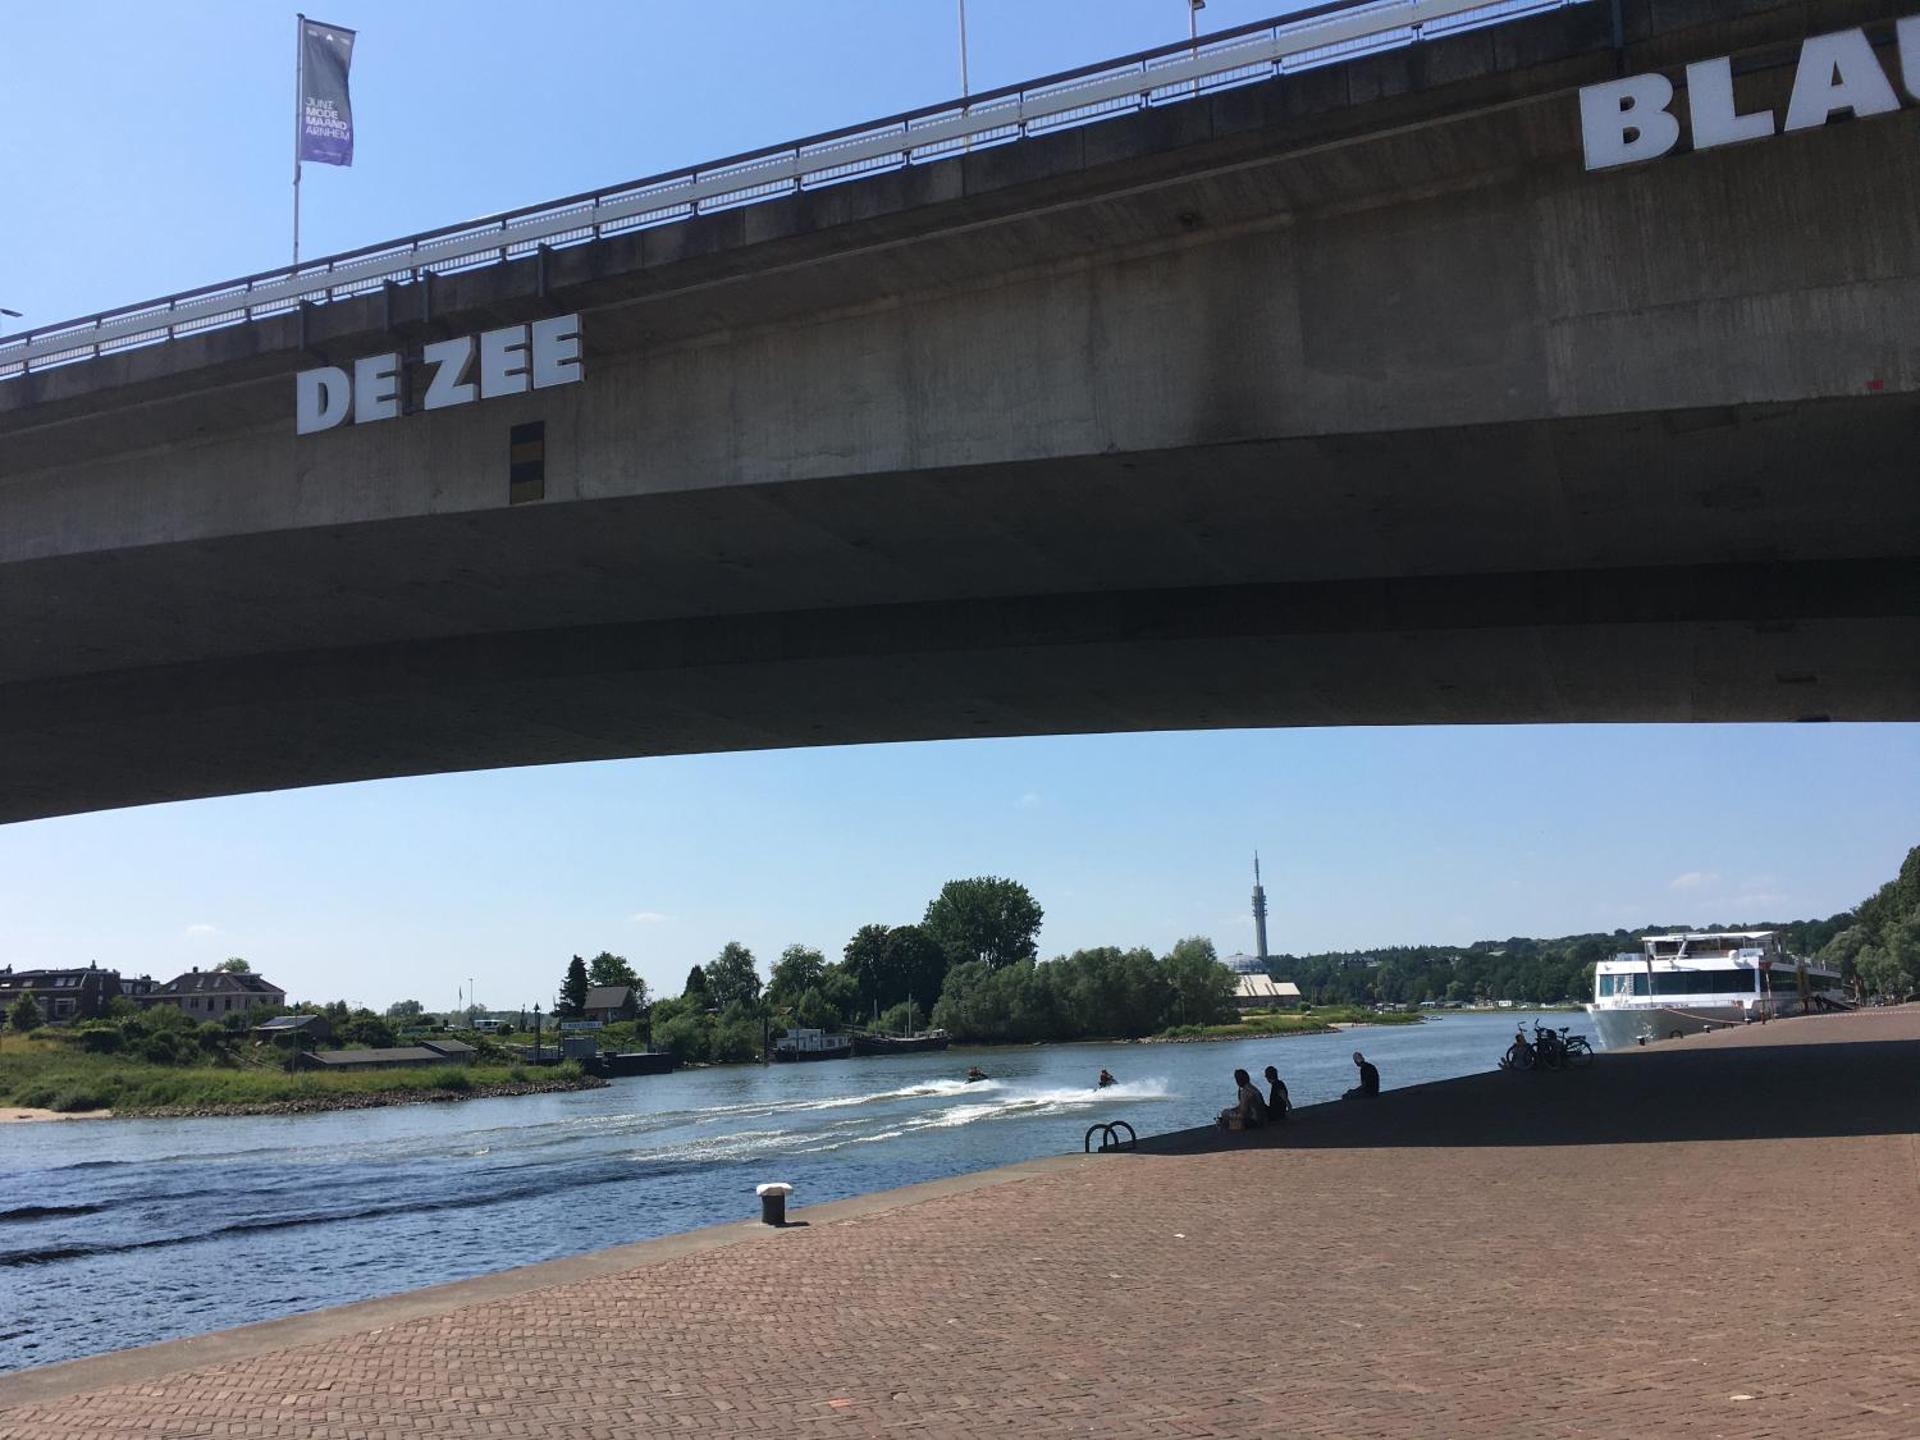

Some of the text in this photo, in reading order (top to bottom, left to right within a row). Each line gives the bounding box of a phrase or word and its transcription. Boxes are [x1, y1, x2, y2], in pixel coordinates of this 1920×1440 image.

[1579, 15, 1920, 172] BLA
[306, 107, 338, 119] MODE
[306, 116, 347, 130] MAAND
[306, 126, 350, 141] ARNHEM
[297, 313, 585, 435] DE ZEE
